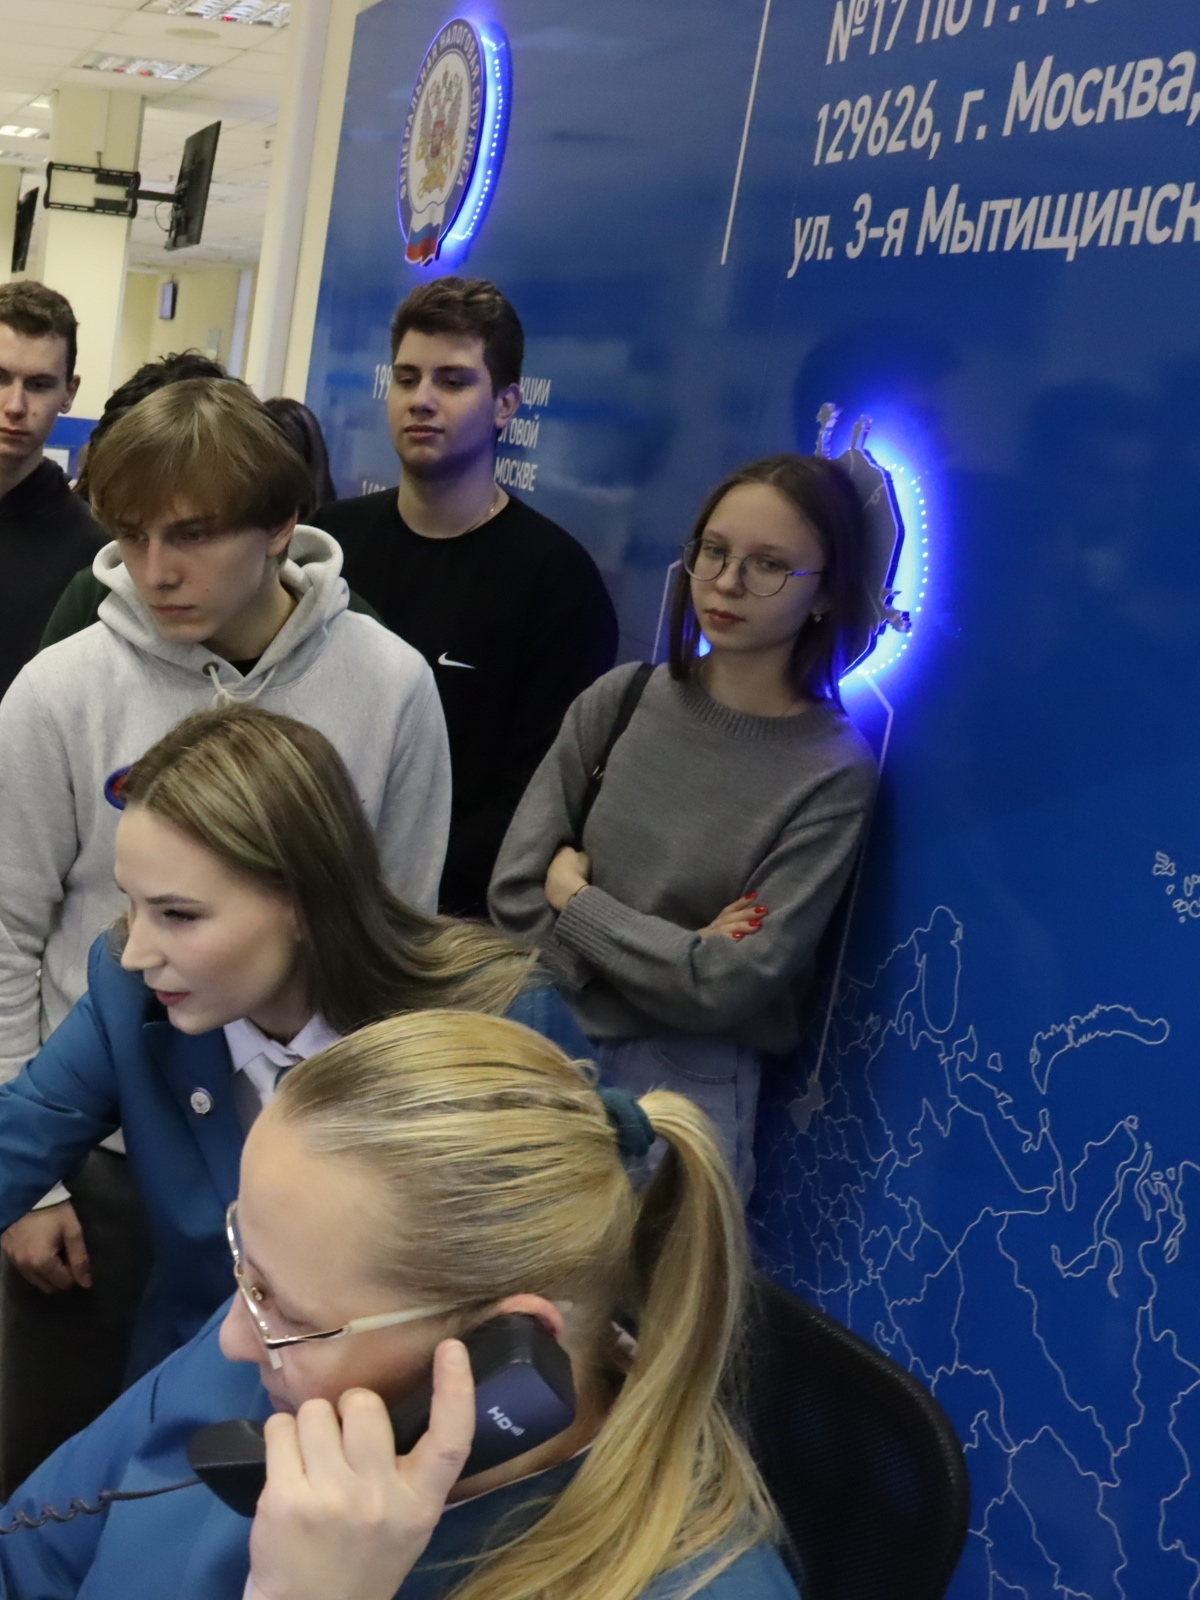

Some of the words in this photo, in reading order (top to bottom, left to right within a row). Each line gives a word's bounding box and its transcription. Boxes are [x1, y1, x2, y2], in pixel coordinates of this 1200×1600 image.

[456, 85, 481, 186] СЛУЖБА
[813, 79, 941, 166] 129626,
[955, 89, 986, 143] г.
[1002, 50, 1200, 137] Москва,
[787, 215, 833, 279] ул.
[846, 193, 909, 259] 3-я
[494, 457, 538, 492] МОСКВЕ
